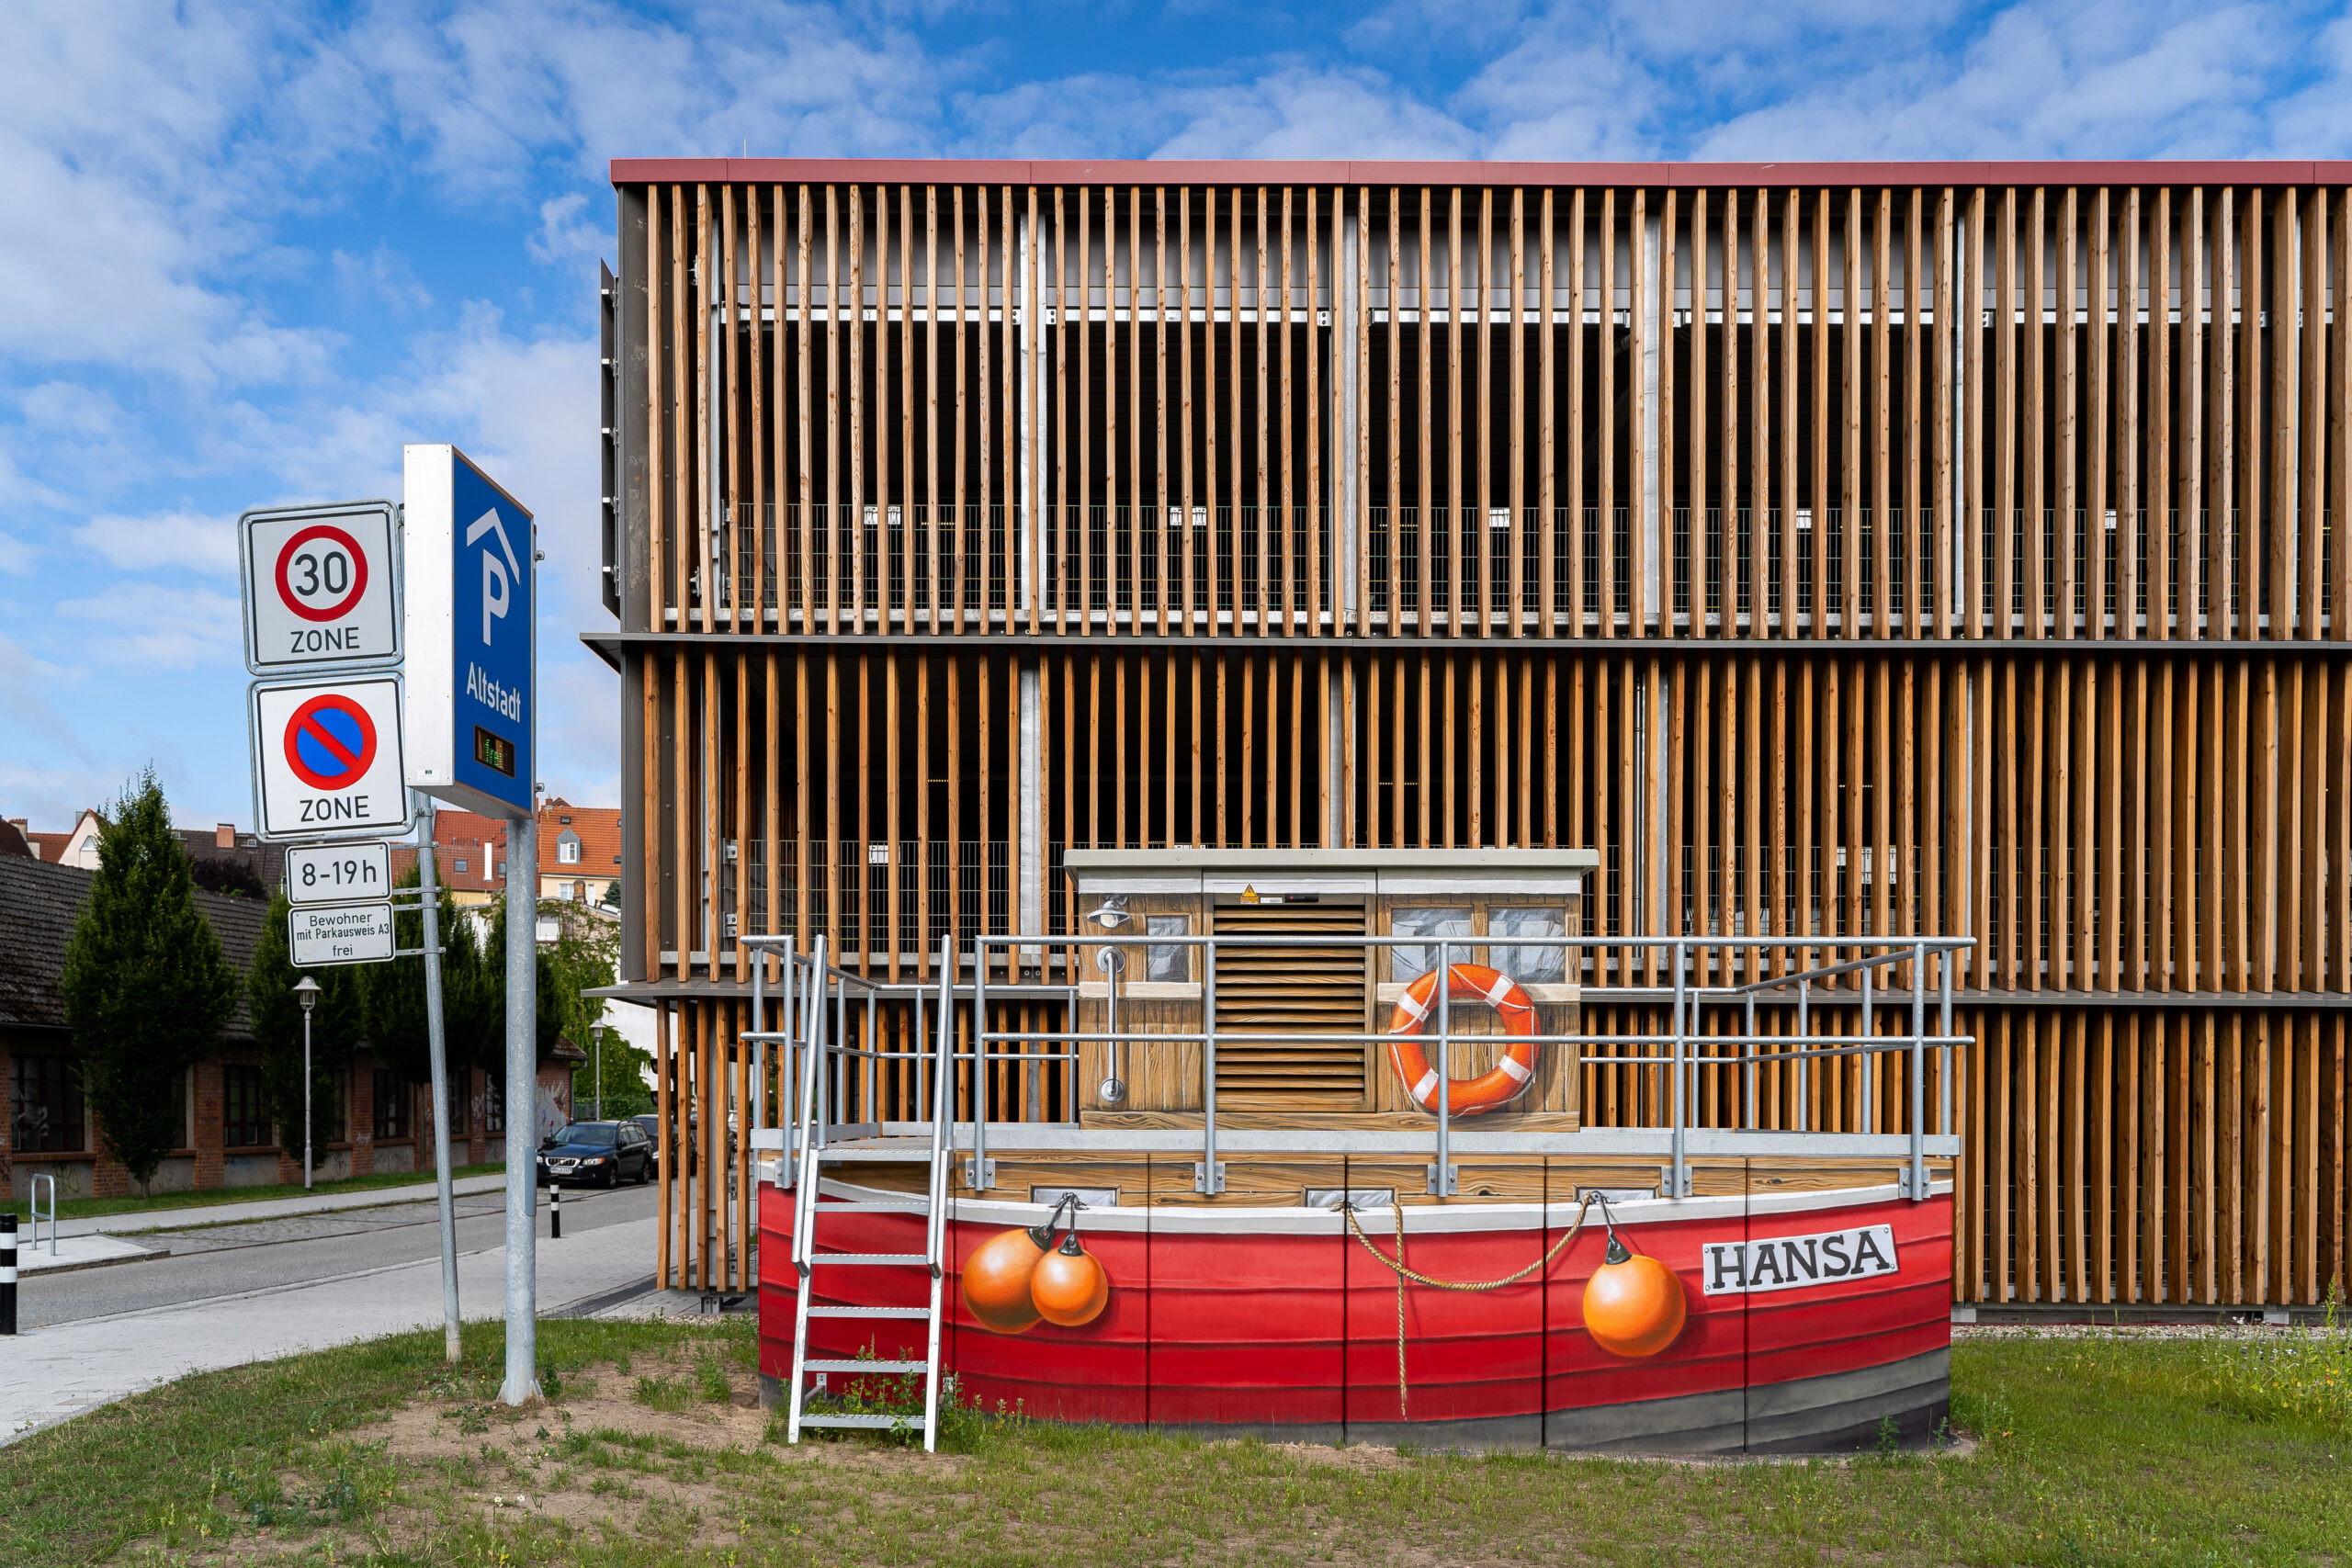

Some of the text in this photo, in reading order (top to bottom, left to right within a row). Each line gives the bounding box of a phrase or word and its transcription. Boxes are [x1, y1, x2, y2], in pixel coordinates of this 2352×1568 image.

[294, 551, 348, 597] 30
[482, 547, 510, 647] P
[290, 626, 360, 654] ZONE
[466, 661, 522, 723] Altstadt
[300, 795, 369, 822] ZONE
[297, 923, 390, 942] mit Parkausweis A3
[310, 913, 373, 927] Bewohner
[333, 943, 354, 957] frei
[1711, 1229, 1890, 1291] HANSA
